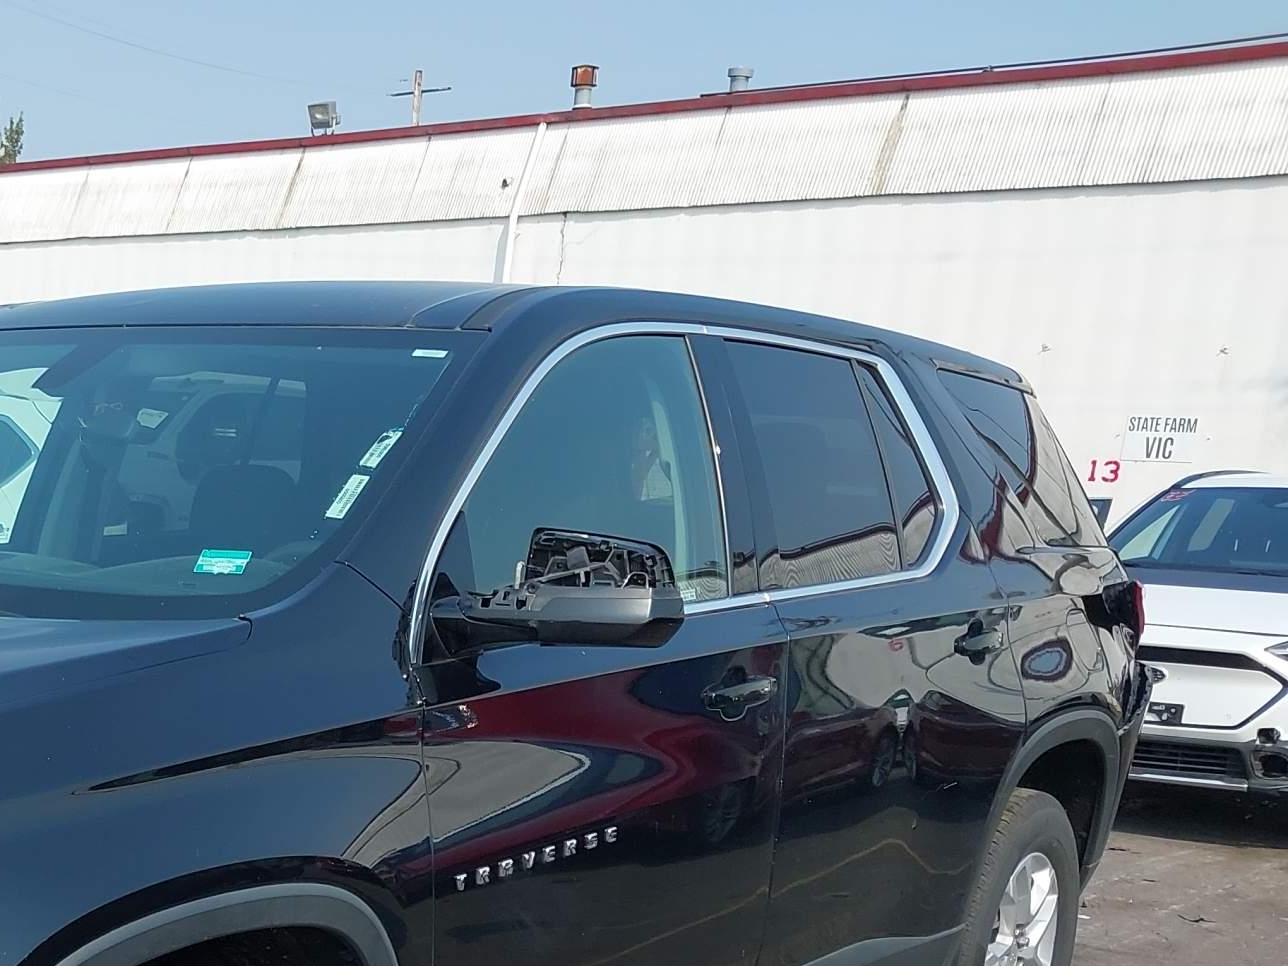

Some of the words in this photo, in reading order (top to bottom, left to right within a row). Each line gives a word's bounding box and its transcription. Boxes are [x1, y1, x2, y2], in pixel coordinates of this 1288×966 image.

[1128, 416, 1162, 433] STATE
[1163, 417, 1199, 434] FARM
[1144, 436, 1175, 460] VIC
[1087, 459, 1122, 483] 13
[453, 826, 619, 892] TRAVERSE
